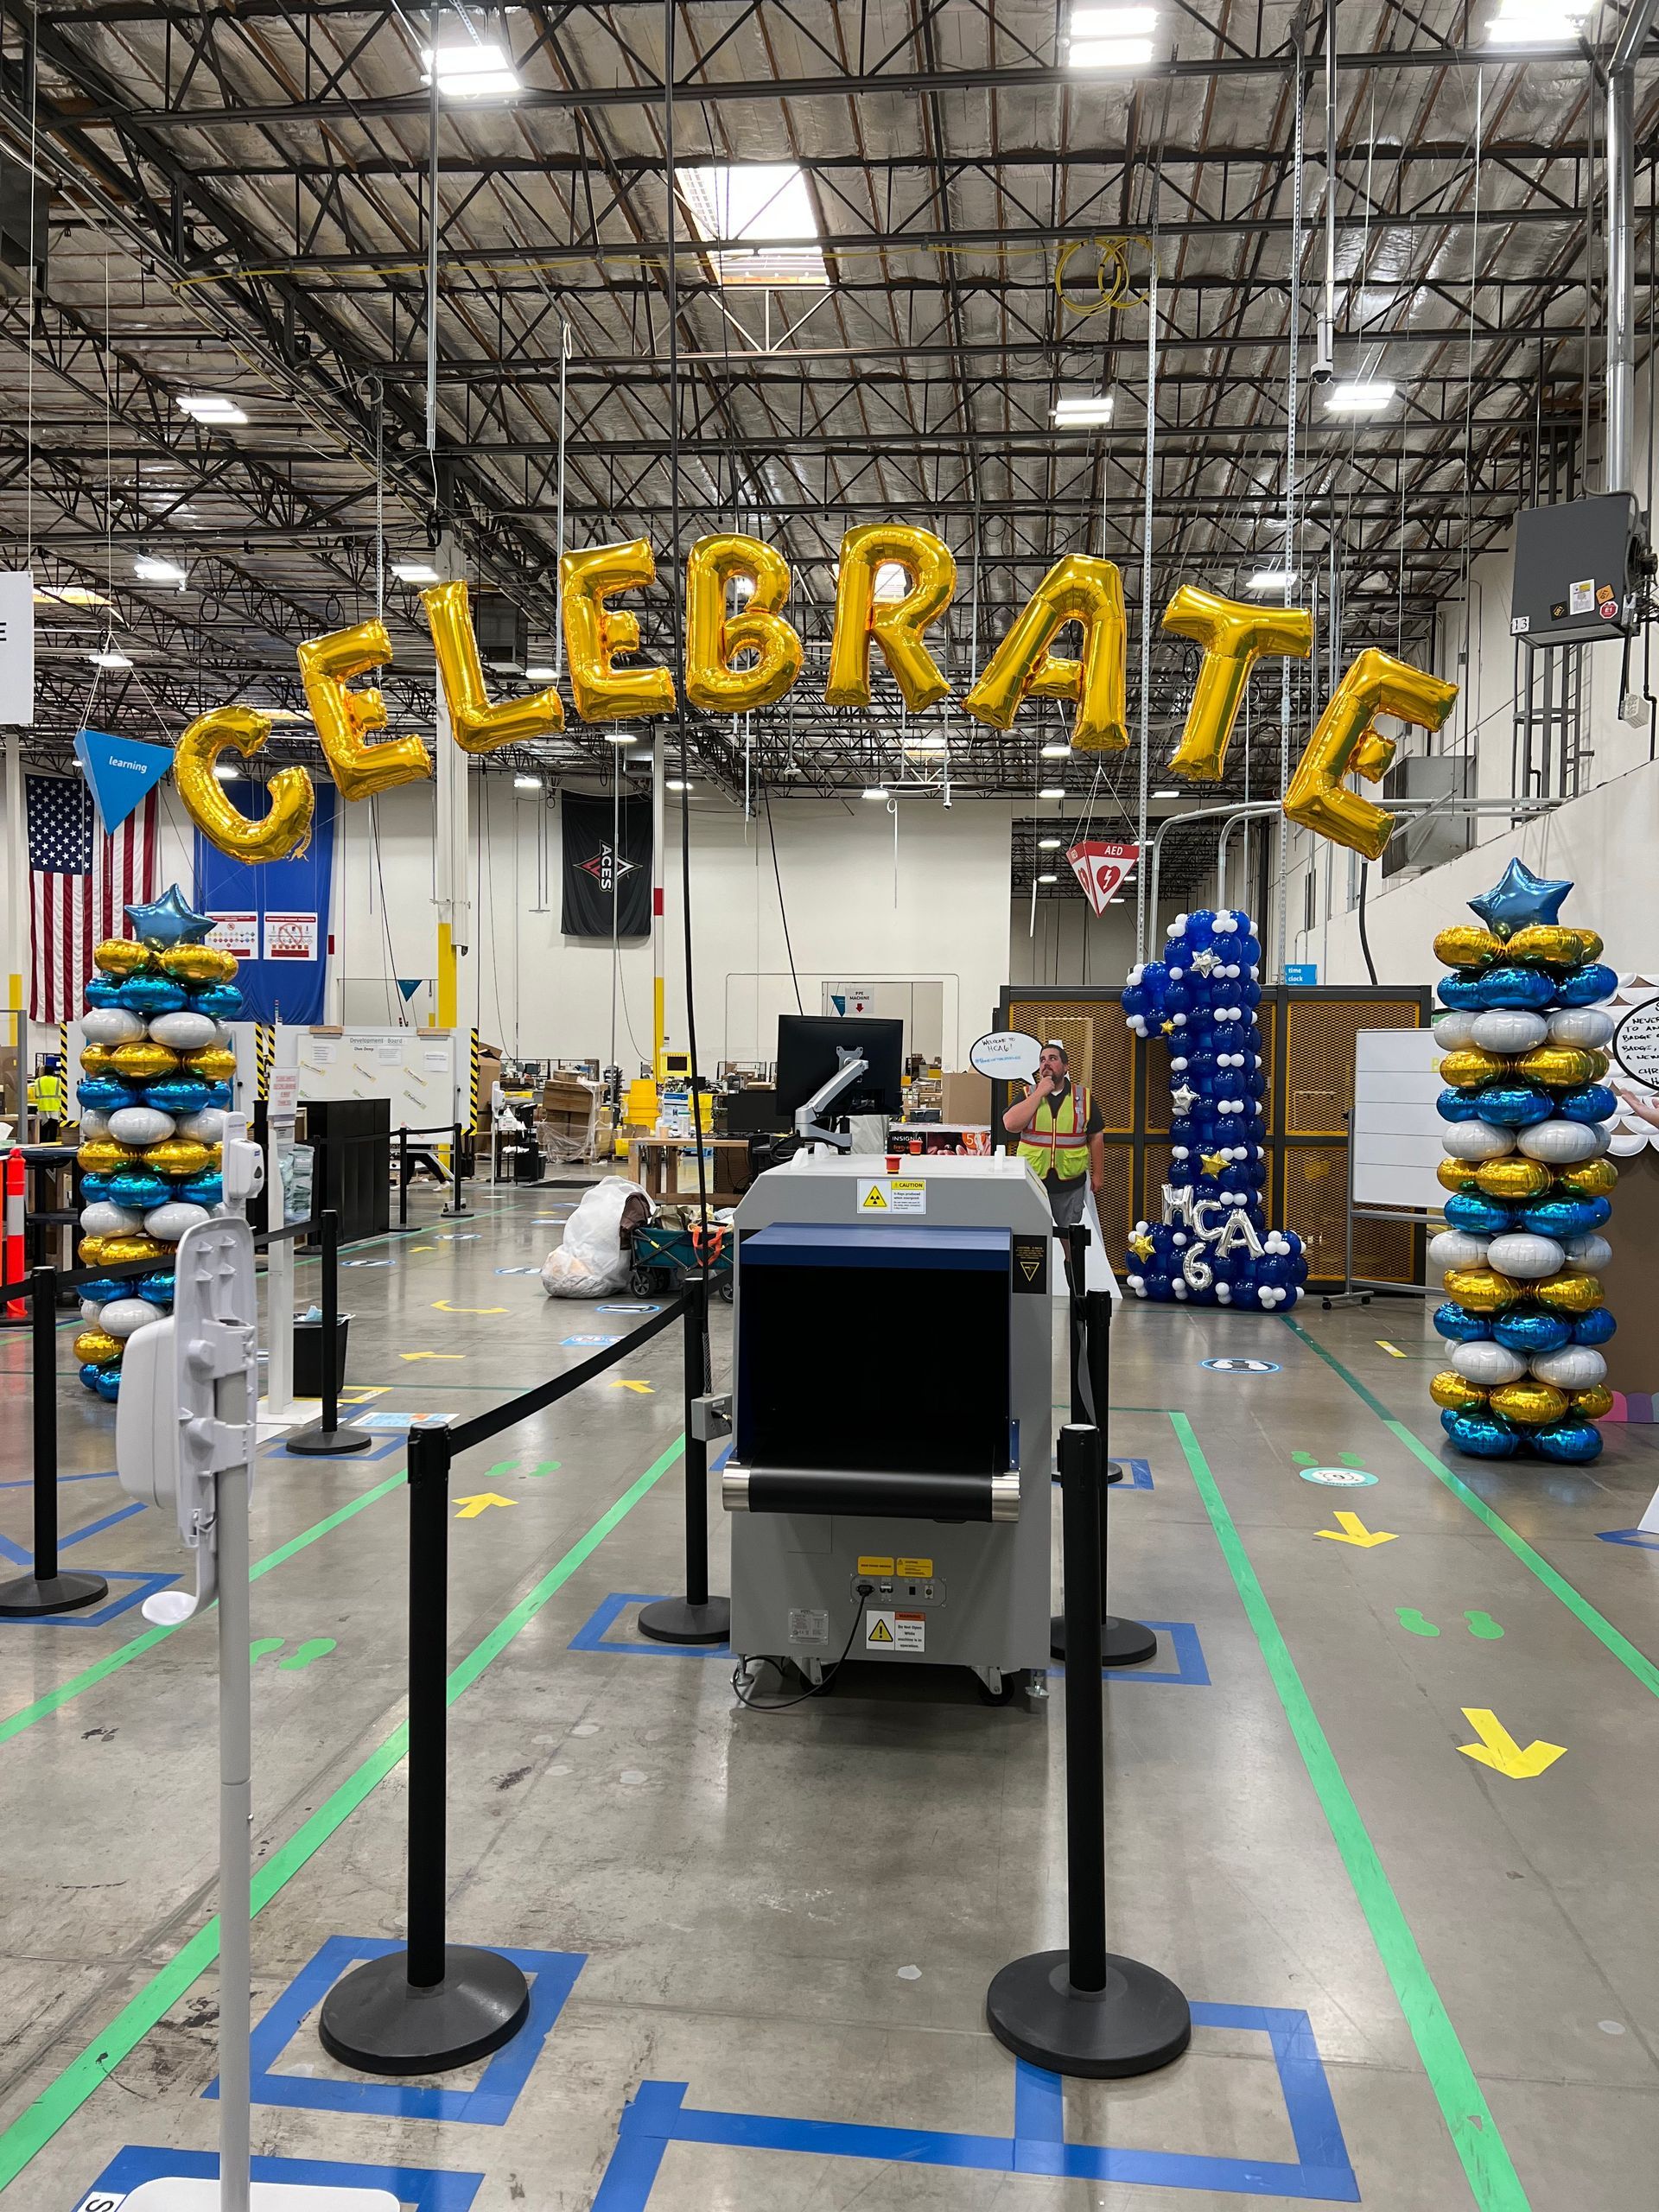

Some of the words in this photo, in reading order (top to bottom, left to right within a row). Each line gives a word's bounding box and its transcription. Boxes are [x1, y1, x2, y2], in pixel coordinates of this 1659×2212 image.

[1515, 618, 1528, 630] 13
[174, 523, 1459, 864] CELEBRATE
[109, 756, 148, 774] learning
[601, 843, 612, 889] ACES
[1104, 845, 1123, 855] AED
[1622, 1034, 1652, 1042] BADGE
[1161, 1183, 1266, 1260] HCA
[1182, 1242, 1213, 1291] 6
